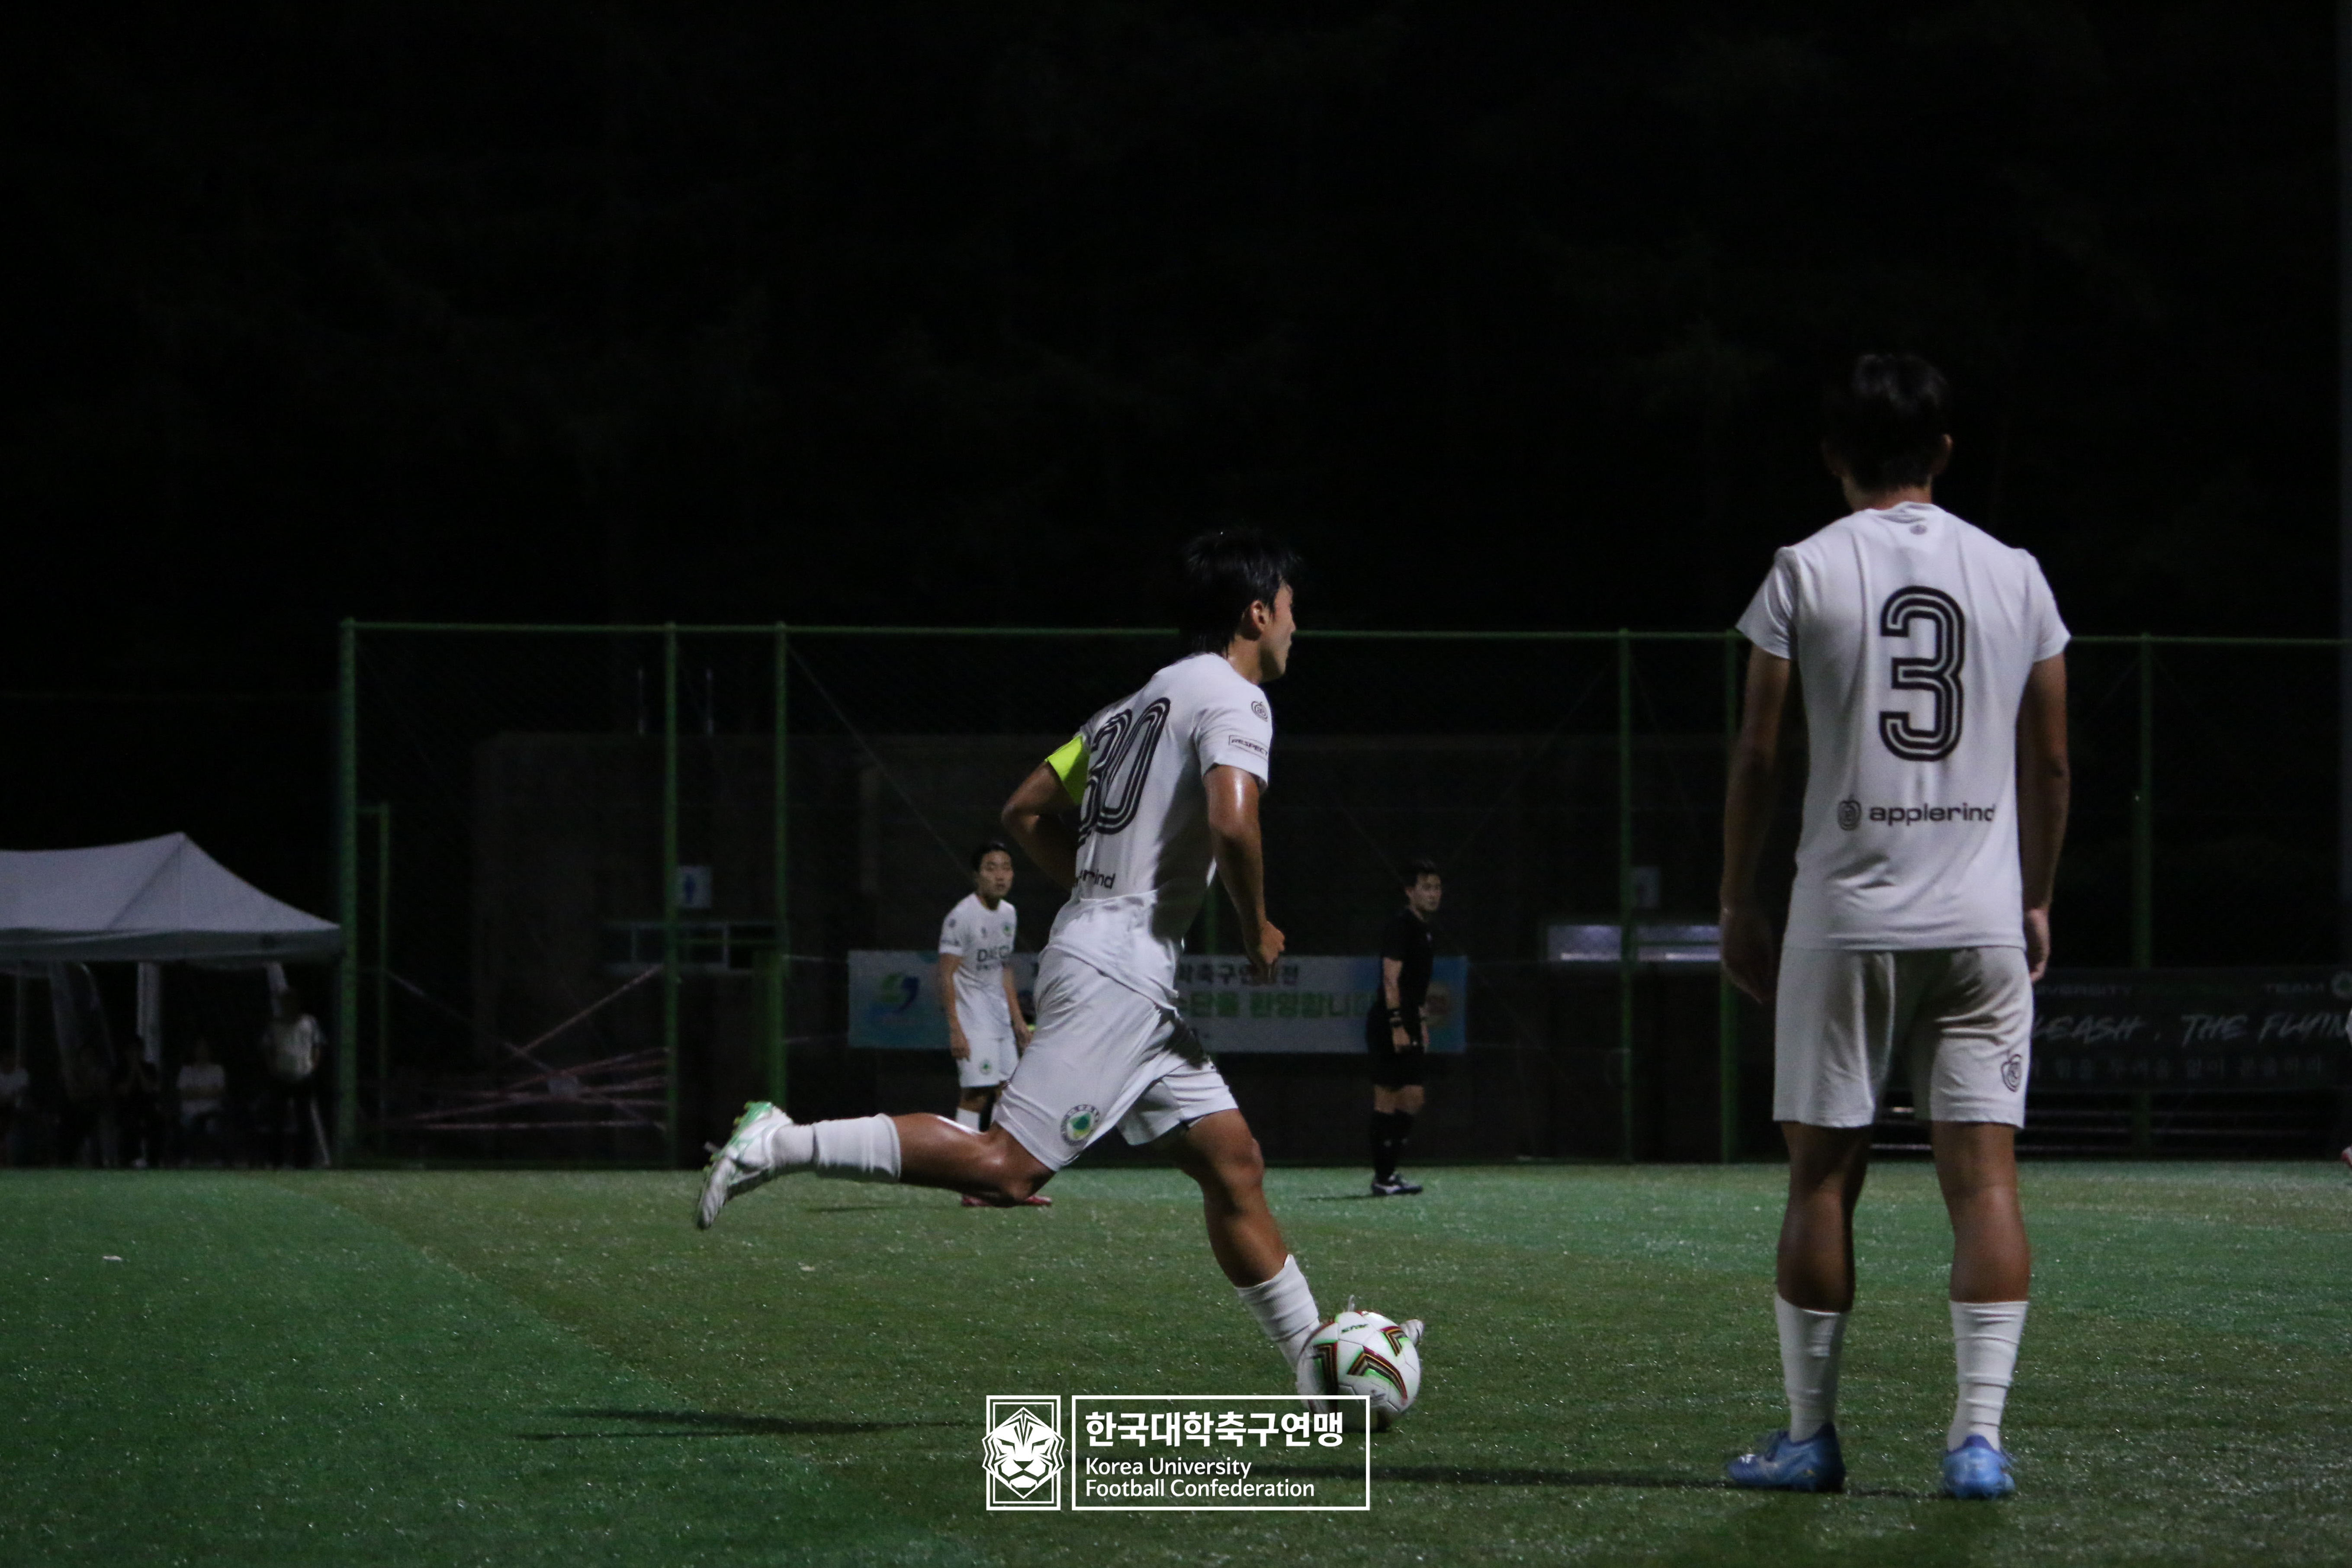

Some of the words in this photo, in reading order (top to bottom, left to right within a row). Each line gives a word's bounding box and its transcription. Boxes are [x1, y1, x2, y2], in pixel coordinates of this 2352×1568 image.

[1879, 586, 1965, 762] 3
[1869, 802, 1996, 826] applerind
[1076, 868, 1116, 889] rind
[2180, 1013, 2248, 1047] THE
[2258, 1011, 2346, 1044] FLYIN
